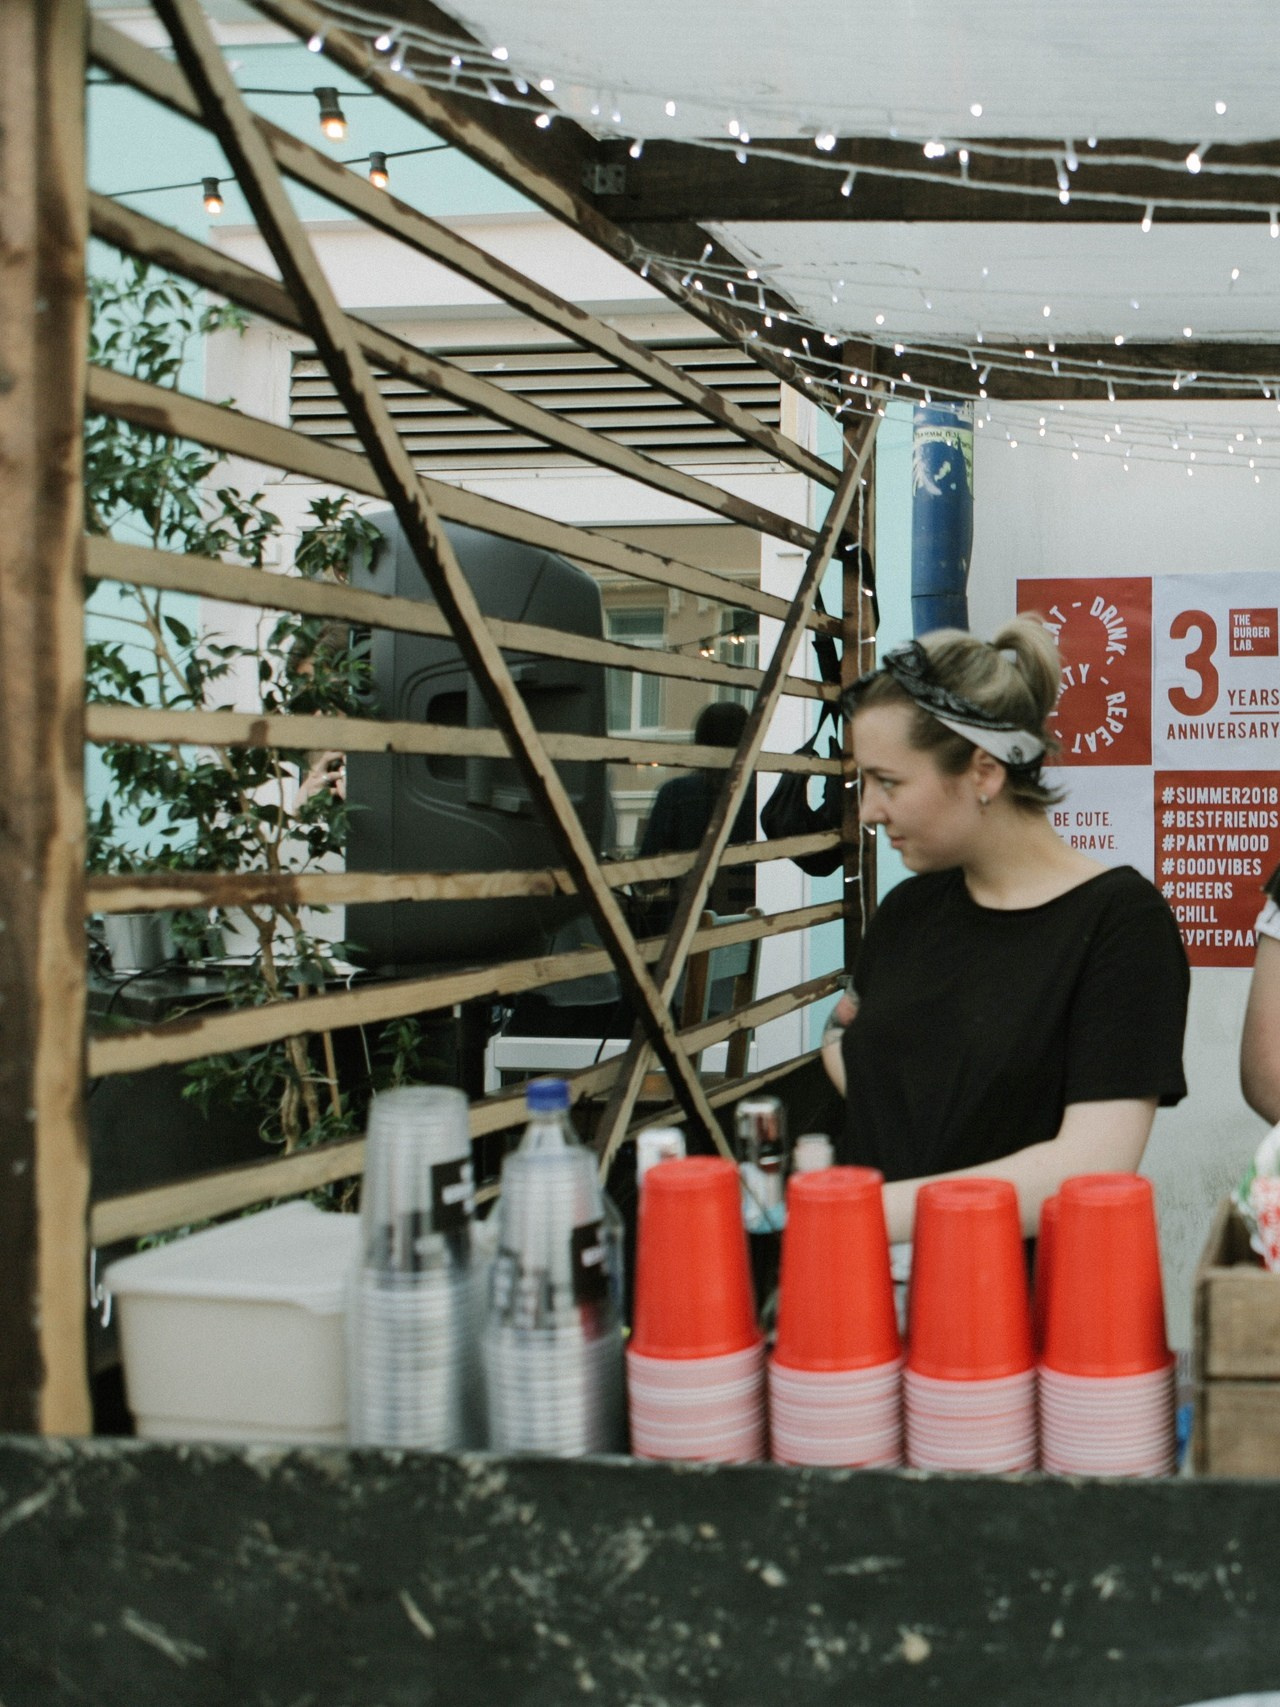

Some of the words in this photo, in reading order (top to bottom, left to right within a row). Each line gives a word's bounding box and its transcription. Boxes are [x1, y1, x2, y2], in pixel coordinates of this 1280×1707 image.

[1090, 596, 1128, 656] DRINK
[1233, 614, 1251, 626] THE
[1233, 626, 1270, 638] BURGER
[1233, 639, 1254, 651] LAB.
[1168, 610, 1219, 716] 3
[1228, 689, 1280, 706] YEARS
[1071, 691, 1128, 753] REPEAT
[1167, 722, 1280, 740] ANNIVERSARY
[1162, 786, 1278, 804] #SUMMER2018
[1054, 812, 1070, 827] BE
[1076, 811, 1112, 827] CUTE.
[1162, 810, 1278, 828] #BESTFRIENDS
[1071, 834, 1118, 849] BRAVE.
[1162, 834, 1269, 852] #PARTYMOOD
[1161, 857, 1262, 875] #GOODVIBES
[1161, 881, 1233, 899] #CHEERS
[1171, 905, 1218, 922] CHILL
[1179, 929, 1258, 947] УРГЕРЛА
